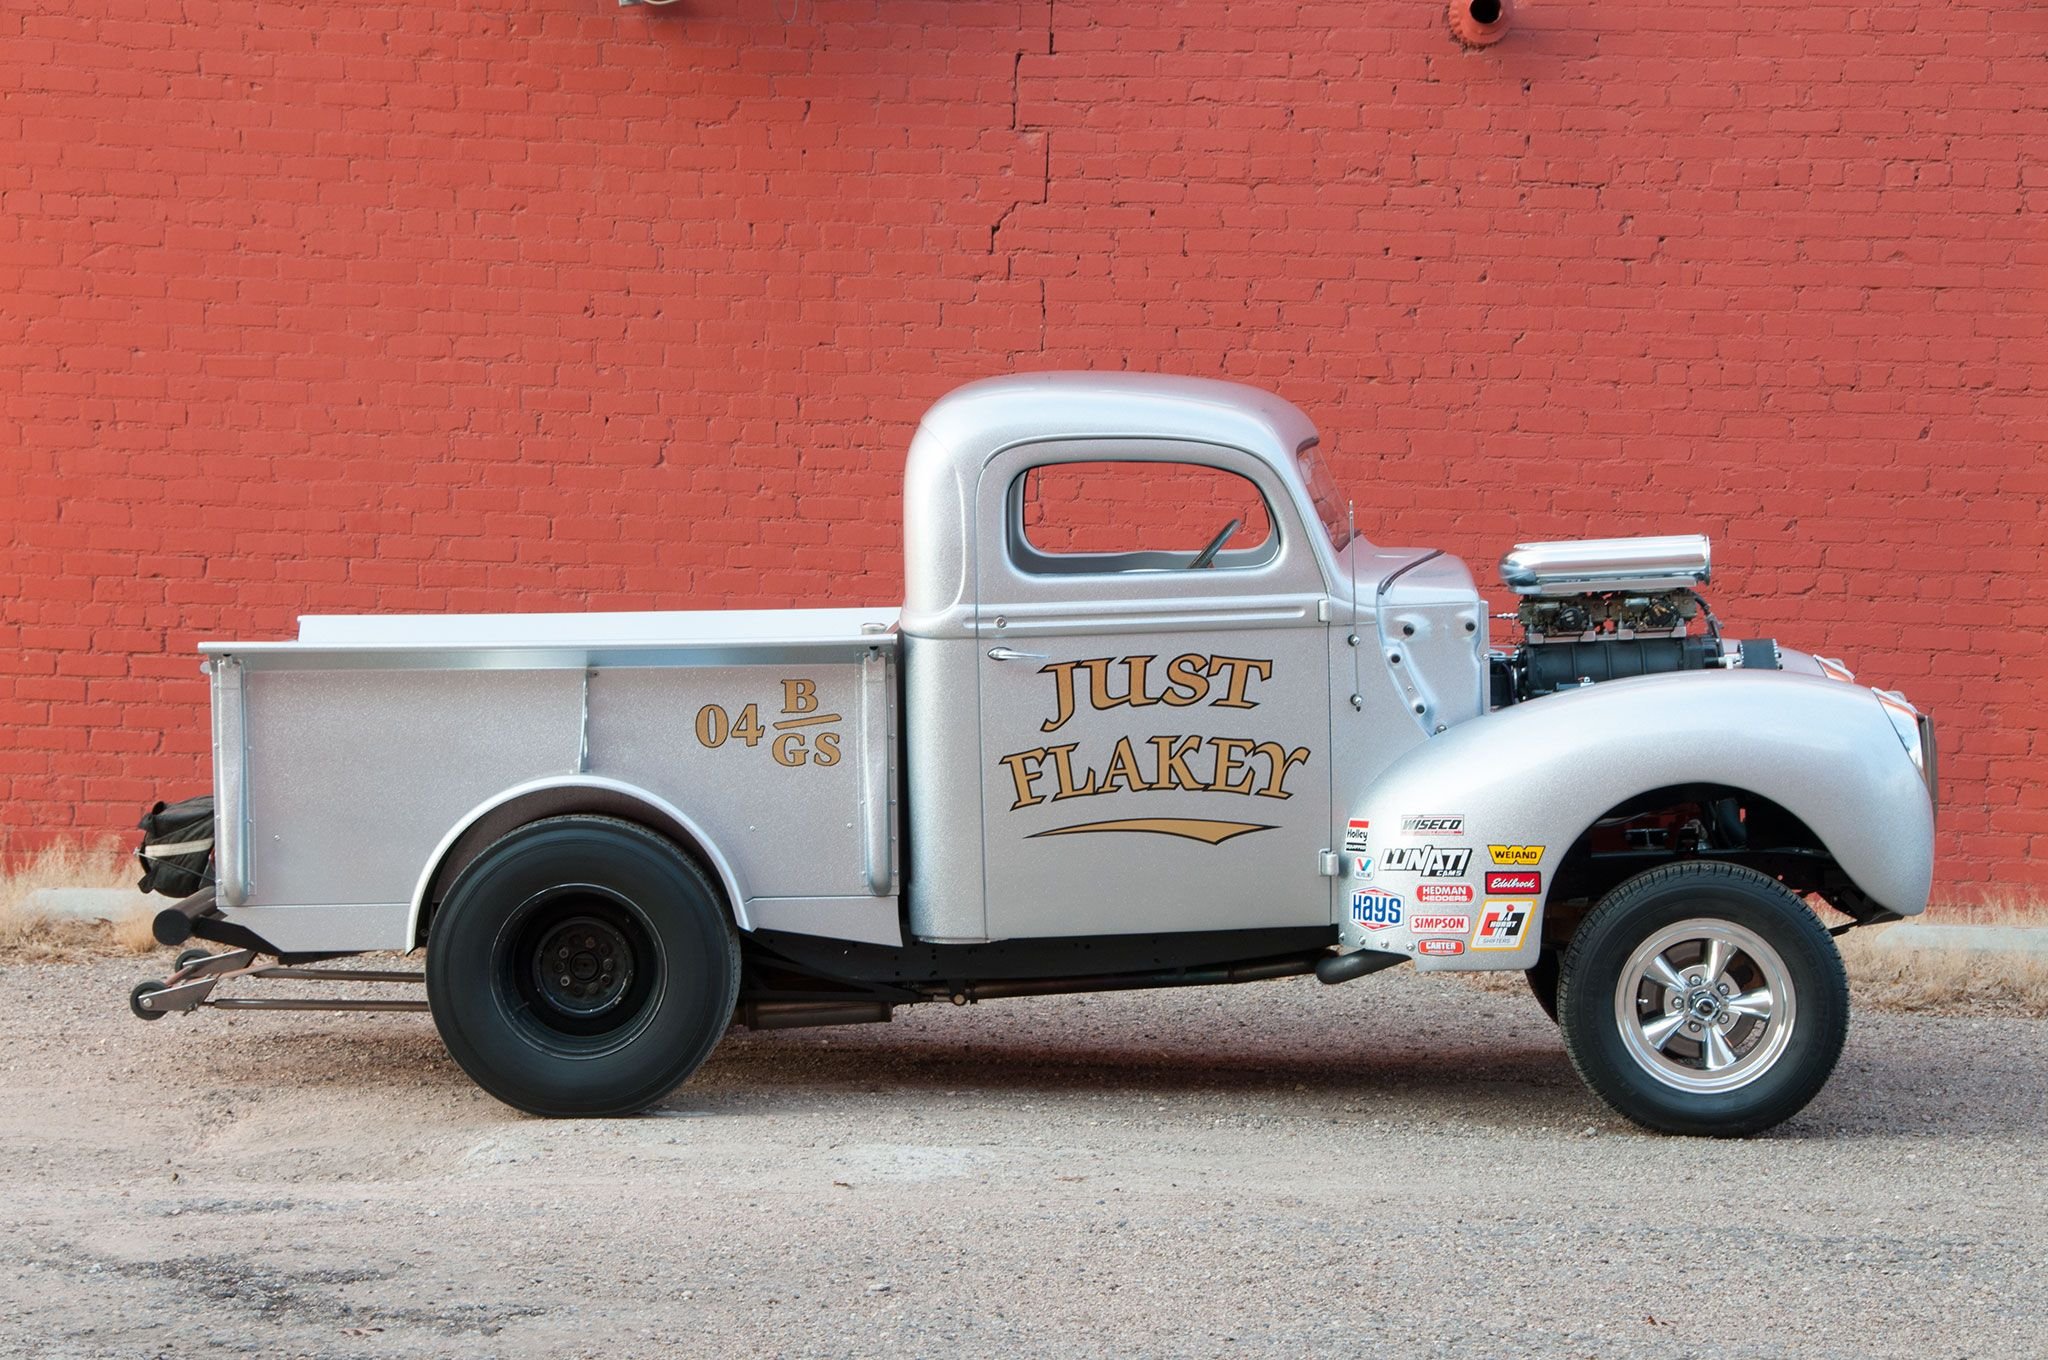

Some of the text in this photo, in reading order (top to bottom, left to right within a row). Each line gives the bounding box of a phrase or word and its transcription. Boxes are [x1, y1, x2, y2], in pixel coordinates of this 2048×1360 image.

[781, 678, 819, 714] B
[1037, 653, 1273, 733] JUST
[695, 703, 766, 749] 04
[772, 732, 842, 767] GS
[998, 734, 1312, 812] FLAKEY
[1402, 819, 1462, 830] WISECO
[1347, 829, 1368, 841] Holley
[1495, 850, 1537, 859] WEIAND
[1379, 845, 1473, 877] LUNATI
[1491, 877, 1535, 888] Edelbrock
[1422, 886, 1466, 895] HEDMAN
[1414, 917, 1464, 928] SIMPSON
[1426, 942, 1456, 950] CARTER
